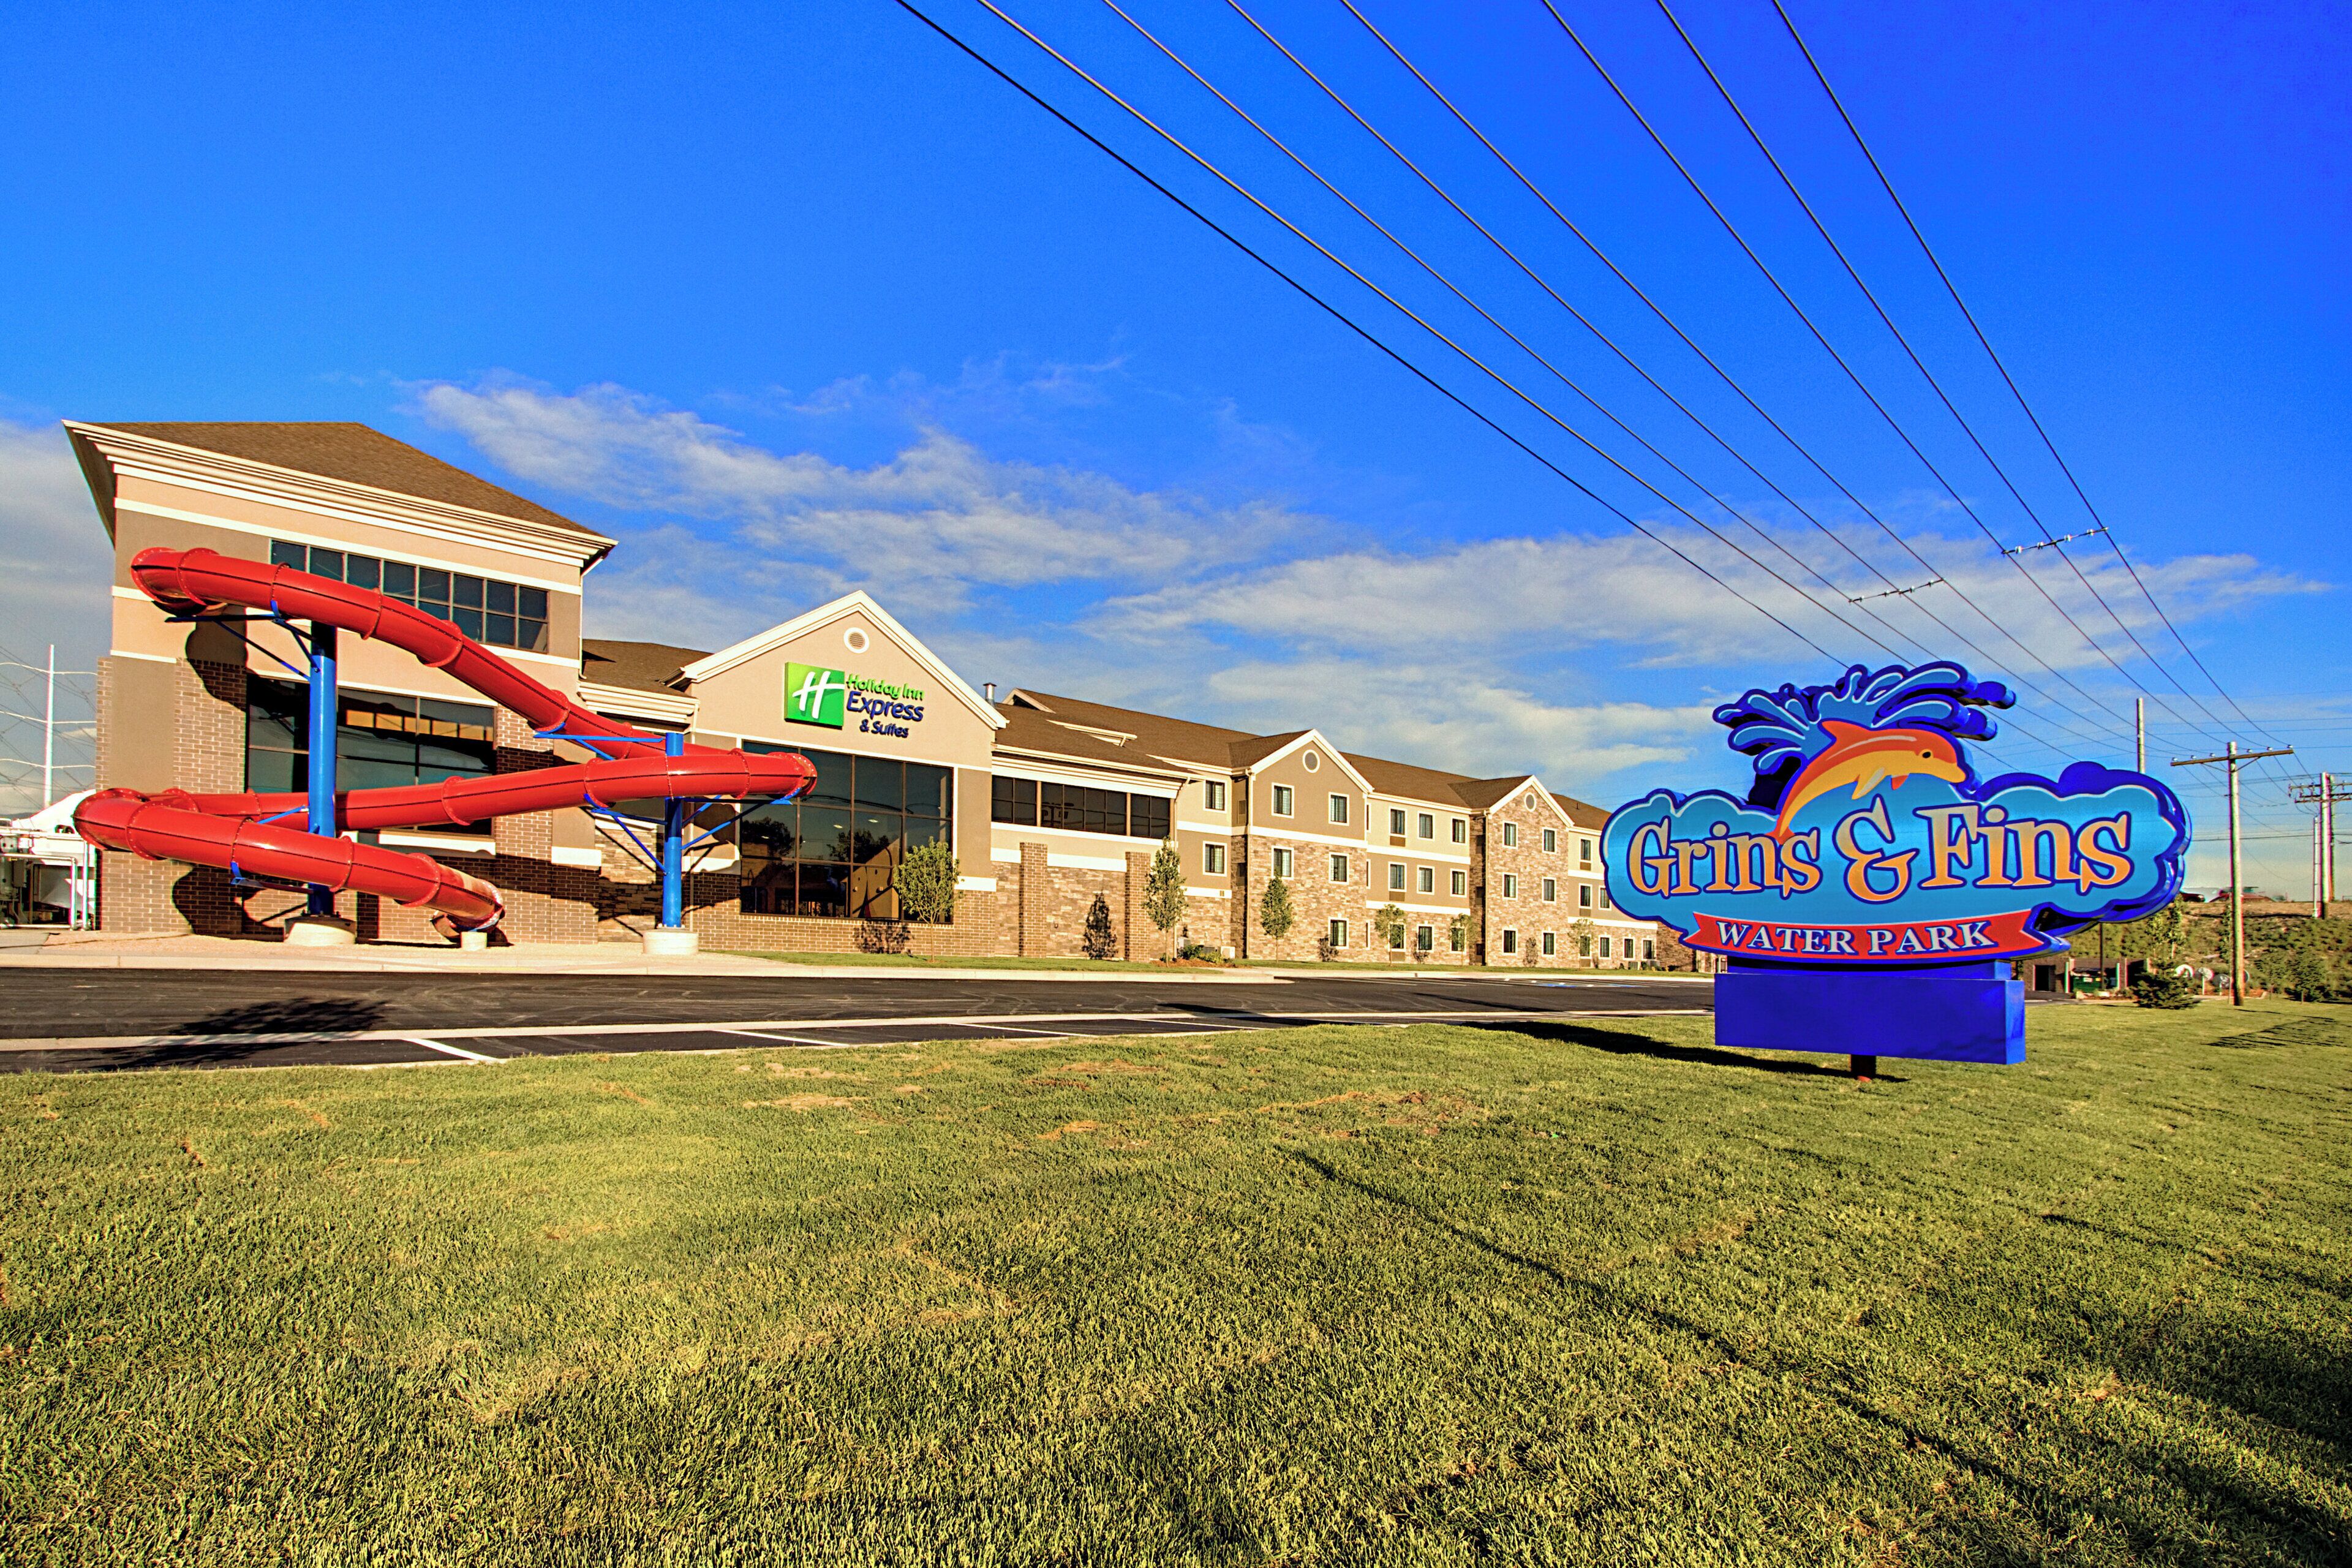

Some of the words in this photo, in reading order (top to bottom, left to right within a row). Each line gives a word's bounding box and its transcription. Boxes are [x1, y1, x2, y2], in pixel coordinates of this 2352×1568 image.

[846, 674, 902, 699] Holiday
[902, 683, 925, 700] Inn
[846, 690, 924, 722] Express
[859, 718, 869, 733] &
[871, 720, 910, 739] Suites
[1627, 816, 1823, 900] Grins
[1832, 794, 1920, 904] &
[1912, 803, 2135, 896] Fins
[1716, 921, 1858, 956] WATER
[1868, 921, 1998, 956] PARK
